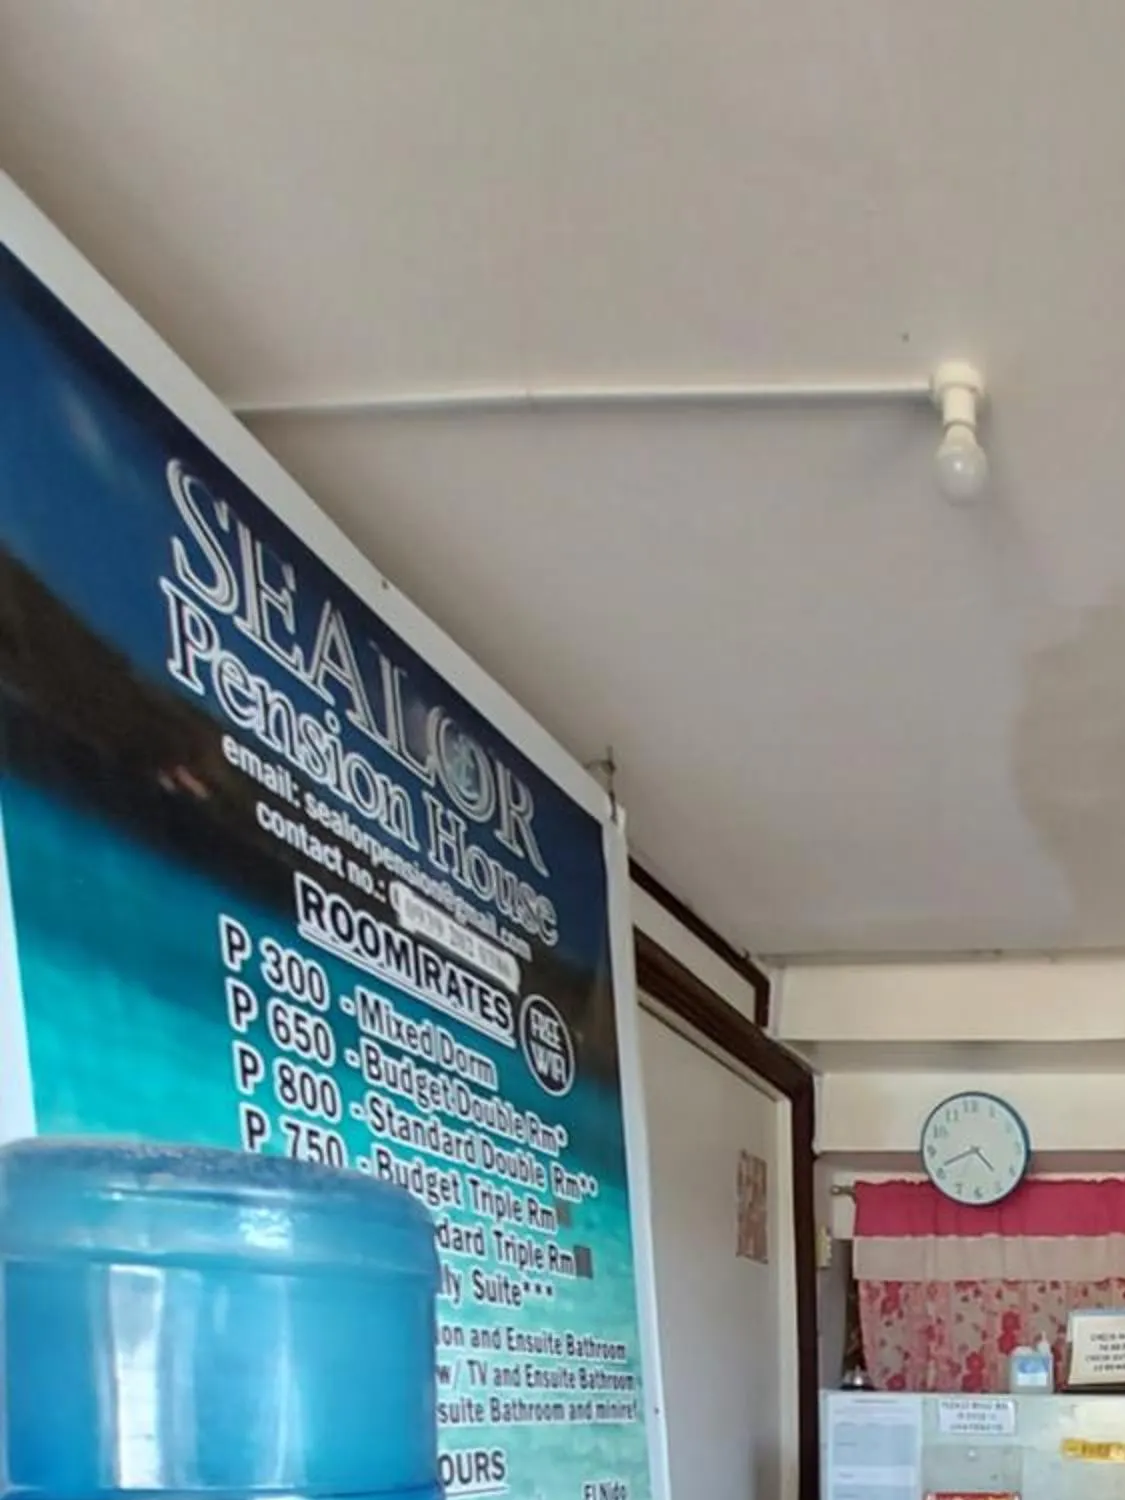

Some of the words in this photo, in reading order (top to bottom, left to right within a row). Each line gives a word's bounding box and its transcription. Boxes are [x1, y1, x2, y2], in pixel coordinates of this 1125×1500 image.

[166, 459, 550, 877] SEALOR
[159, 576, 420, 853] Pension
[422, 790, 559, 947] House
[222, 736, 300, 808] email:
[257, 801, 344, 879] contact
[299, 878, 413, 980] ROOM
[420, 947, 513, 1033] RATES
[223, 918, 249, 967] P
[262, 942, 328, 1008] 300
[439, 1028, 497, 1089] Dorm
[529, 1007, 562, 1051] FREE
[230, 980, 254, 1030] P
[269, 1001, 334, 1064] 650
[453, 1080, 525, 1140] Double
[236, 1044, 261, 1092] P
[275, 1060, 340, 1121] 800
[480, 1136, 546, 1188] Double
[243, 1105, 267, 1151] P
[281, 1119, 345, 1169] 750
[467, 1175, 524, 1223] Triple
[527, 1195, 557, 1233] Rm
[491, 1228, 545, 1271] Triple
[548, 1243, 577, 1277] Rm
[467, 1358, 488, 1387] TV
[493, 1363, 521, 1388] and
[524, 1362, 577, 1389] Ensuite
[578, 1366, 635, 1391] Bathroom
[470, 1325, 501, 1351] and
[506, 1326, 562, 1356] Ensuite
[566, 1332, 627, 1361] Bathroom
[438, 1396, 485, 1424] suite
[490, 1395, 565, 1423] Bathroom
[568, 1400, 592, 1420] and
[437, 1449, 506, 1487] OURS
